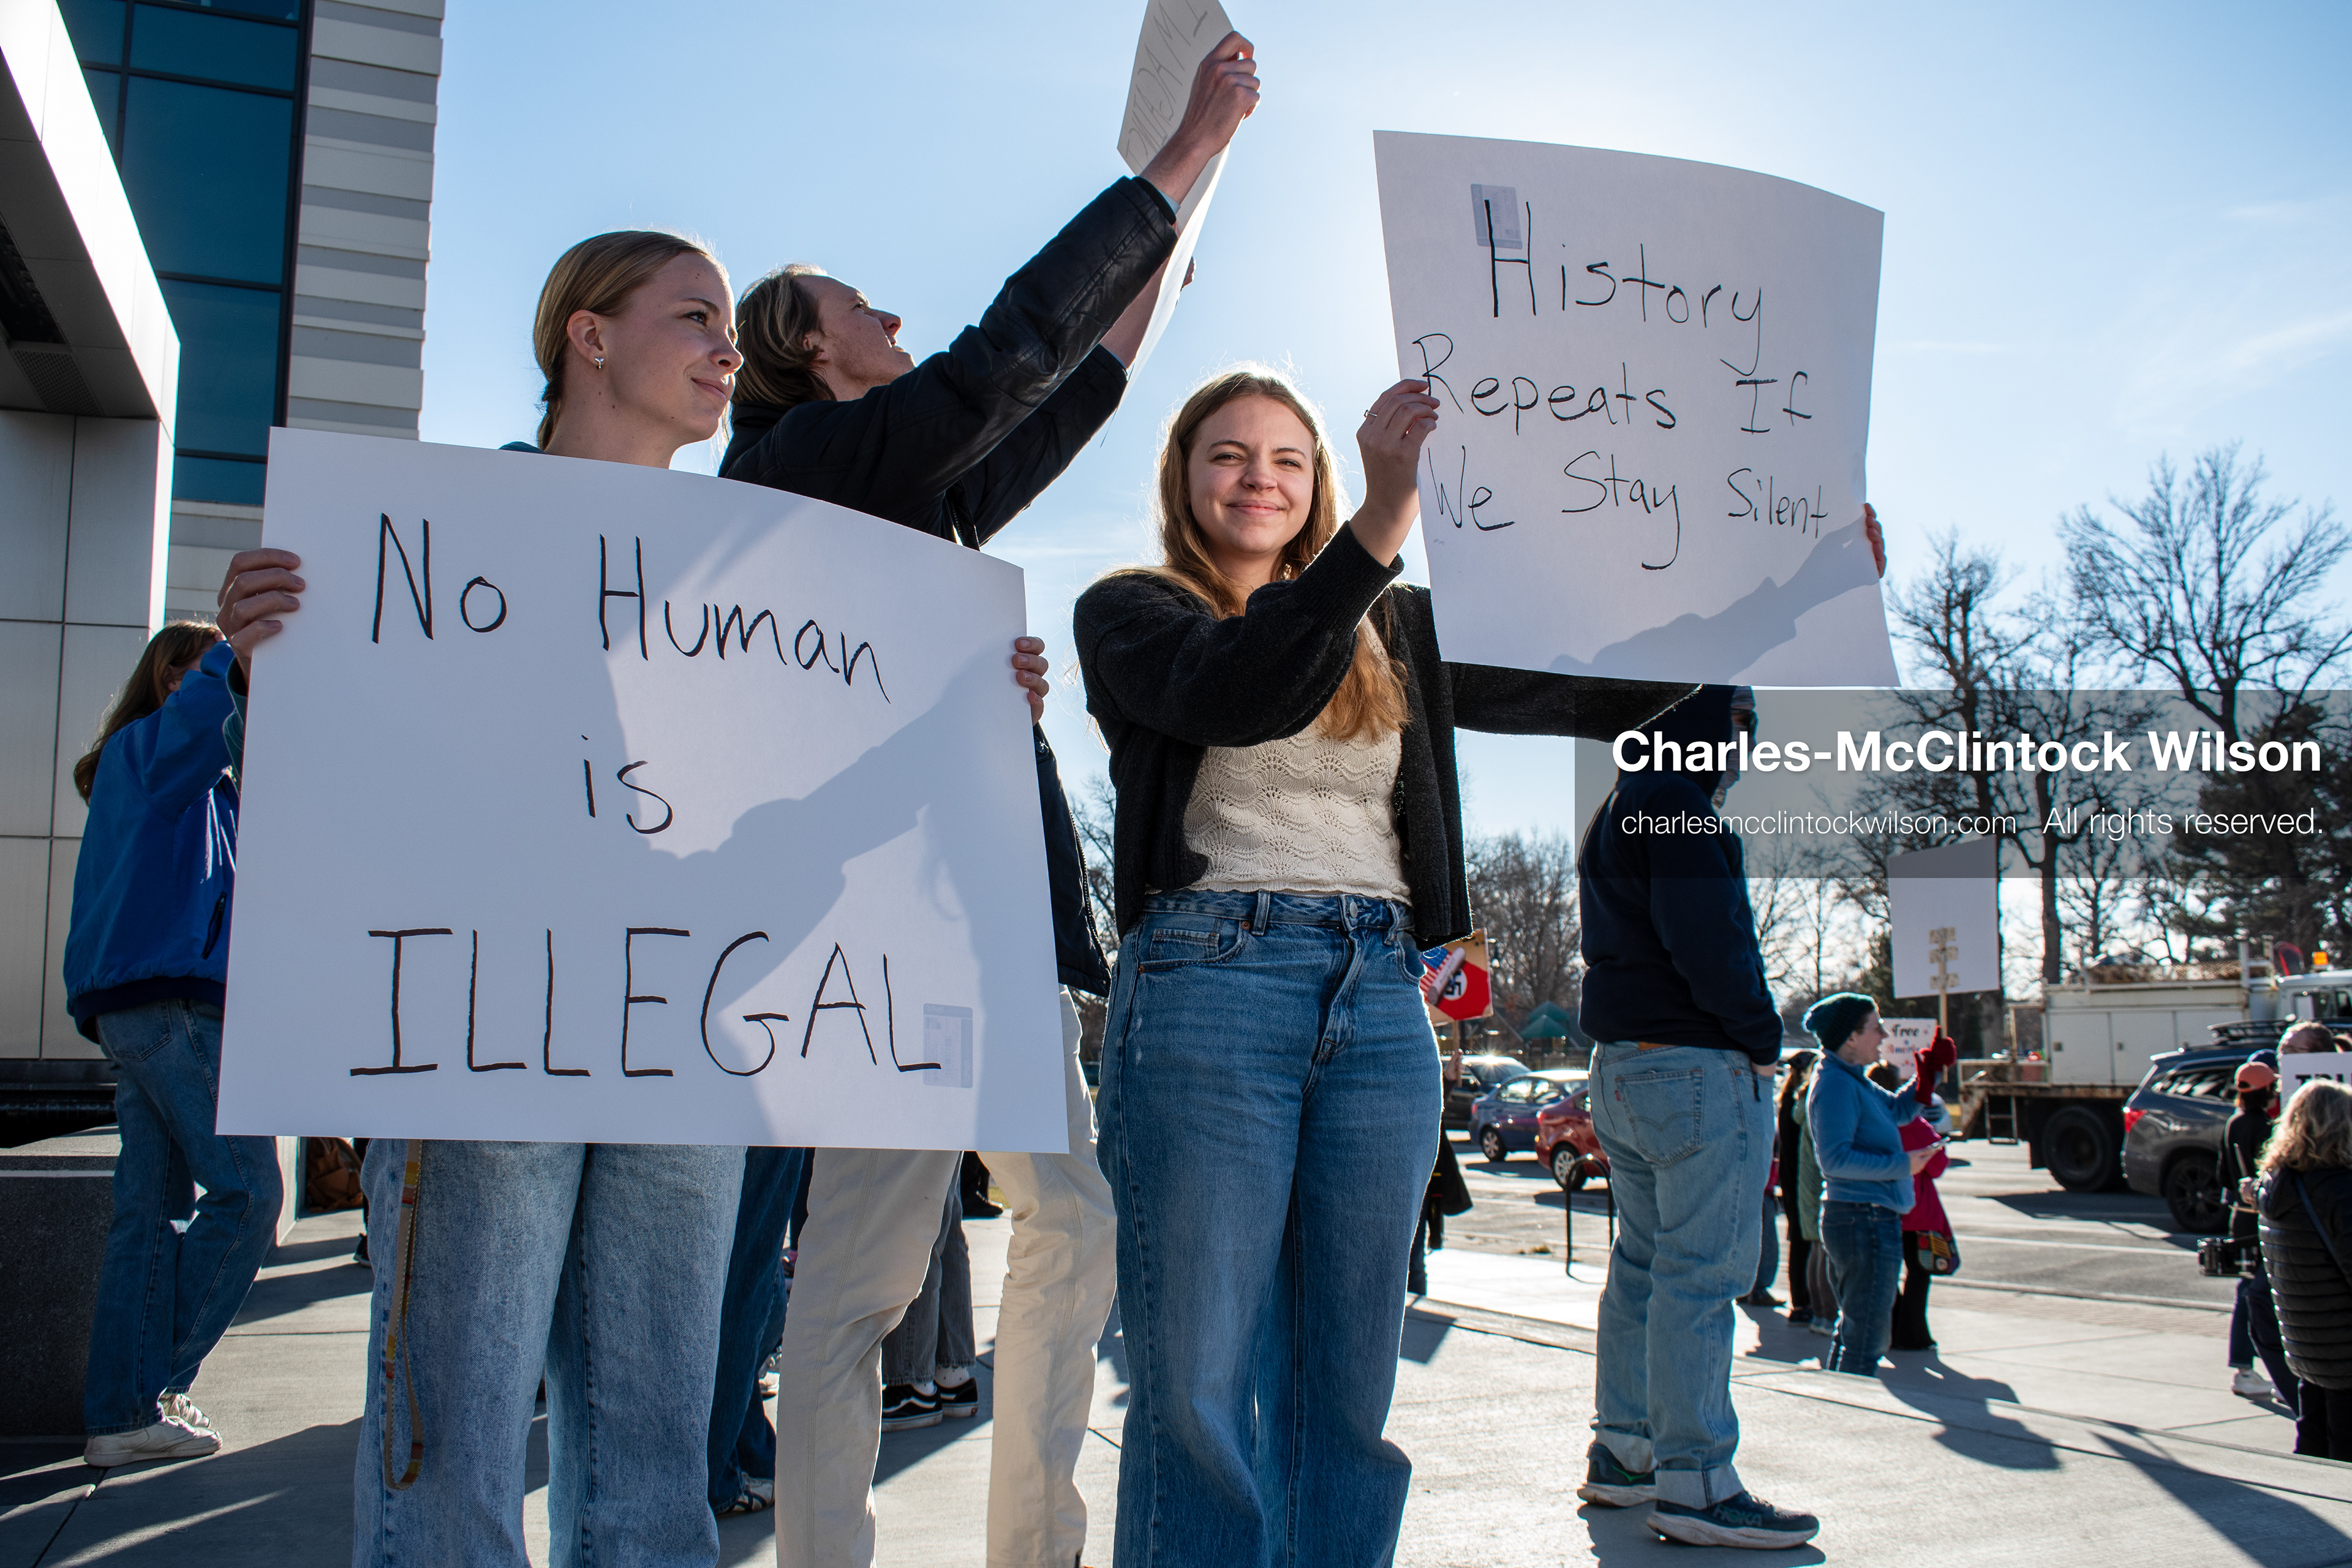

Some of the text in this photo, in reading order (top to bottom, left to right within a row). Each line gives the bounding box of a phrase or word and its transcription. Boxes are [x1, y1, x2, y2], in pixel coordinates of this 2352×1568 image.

[1484, 199, 1762, 376] History
[1412, 333, 1813, 436] Repeats If
[1428, 445, 1828, 571] We Stay Silent
[371, 512, 891, 704] No Human
[581, 734, 673, 835] is
[350, 927, 942, 1078] ILLEGAL
